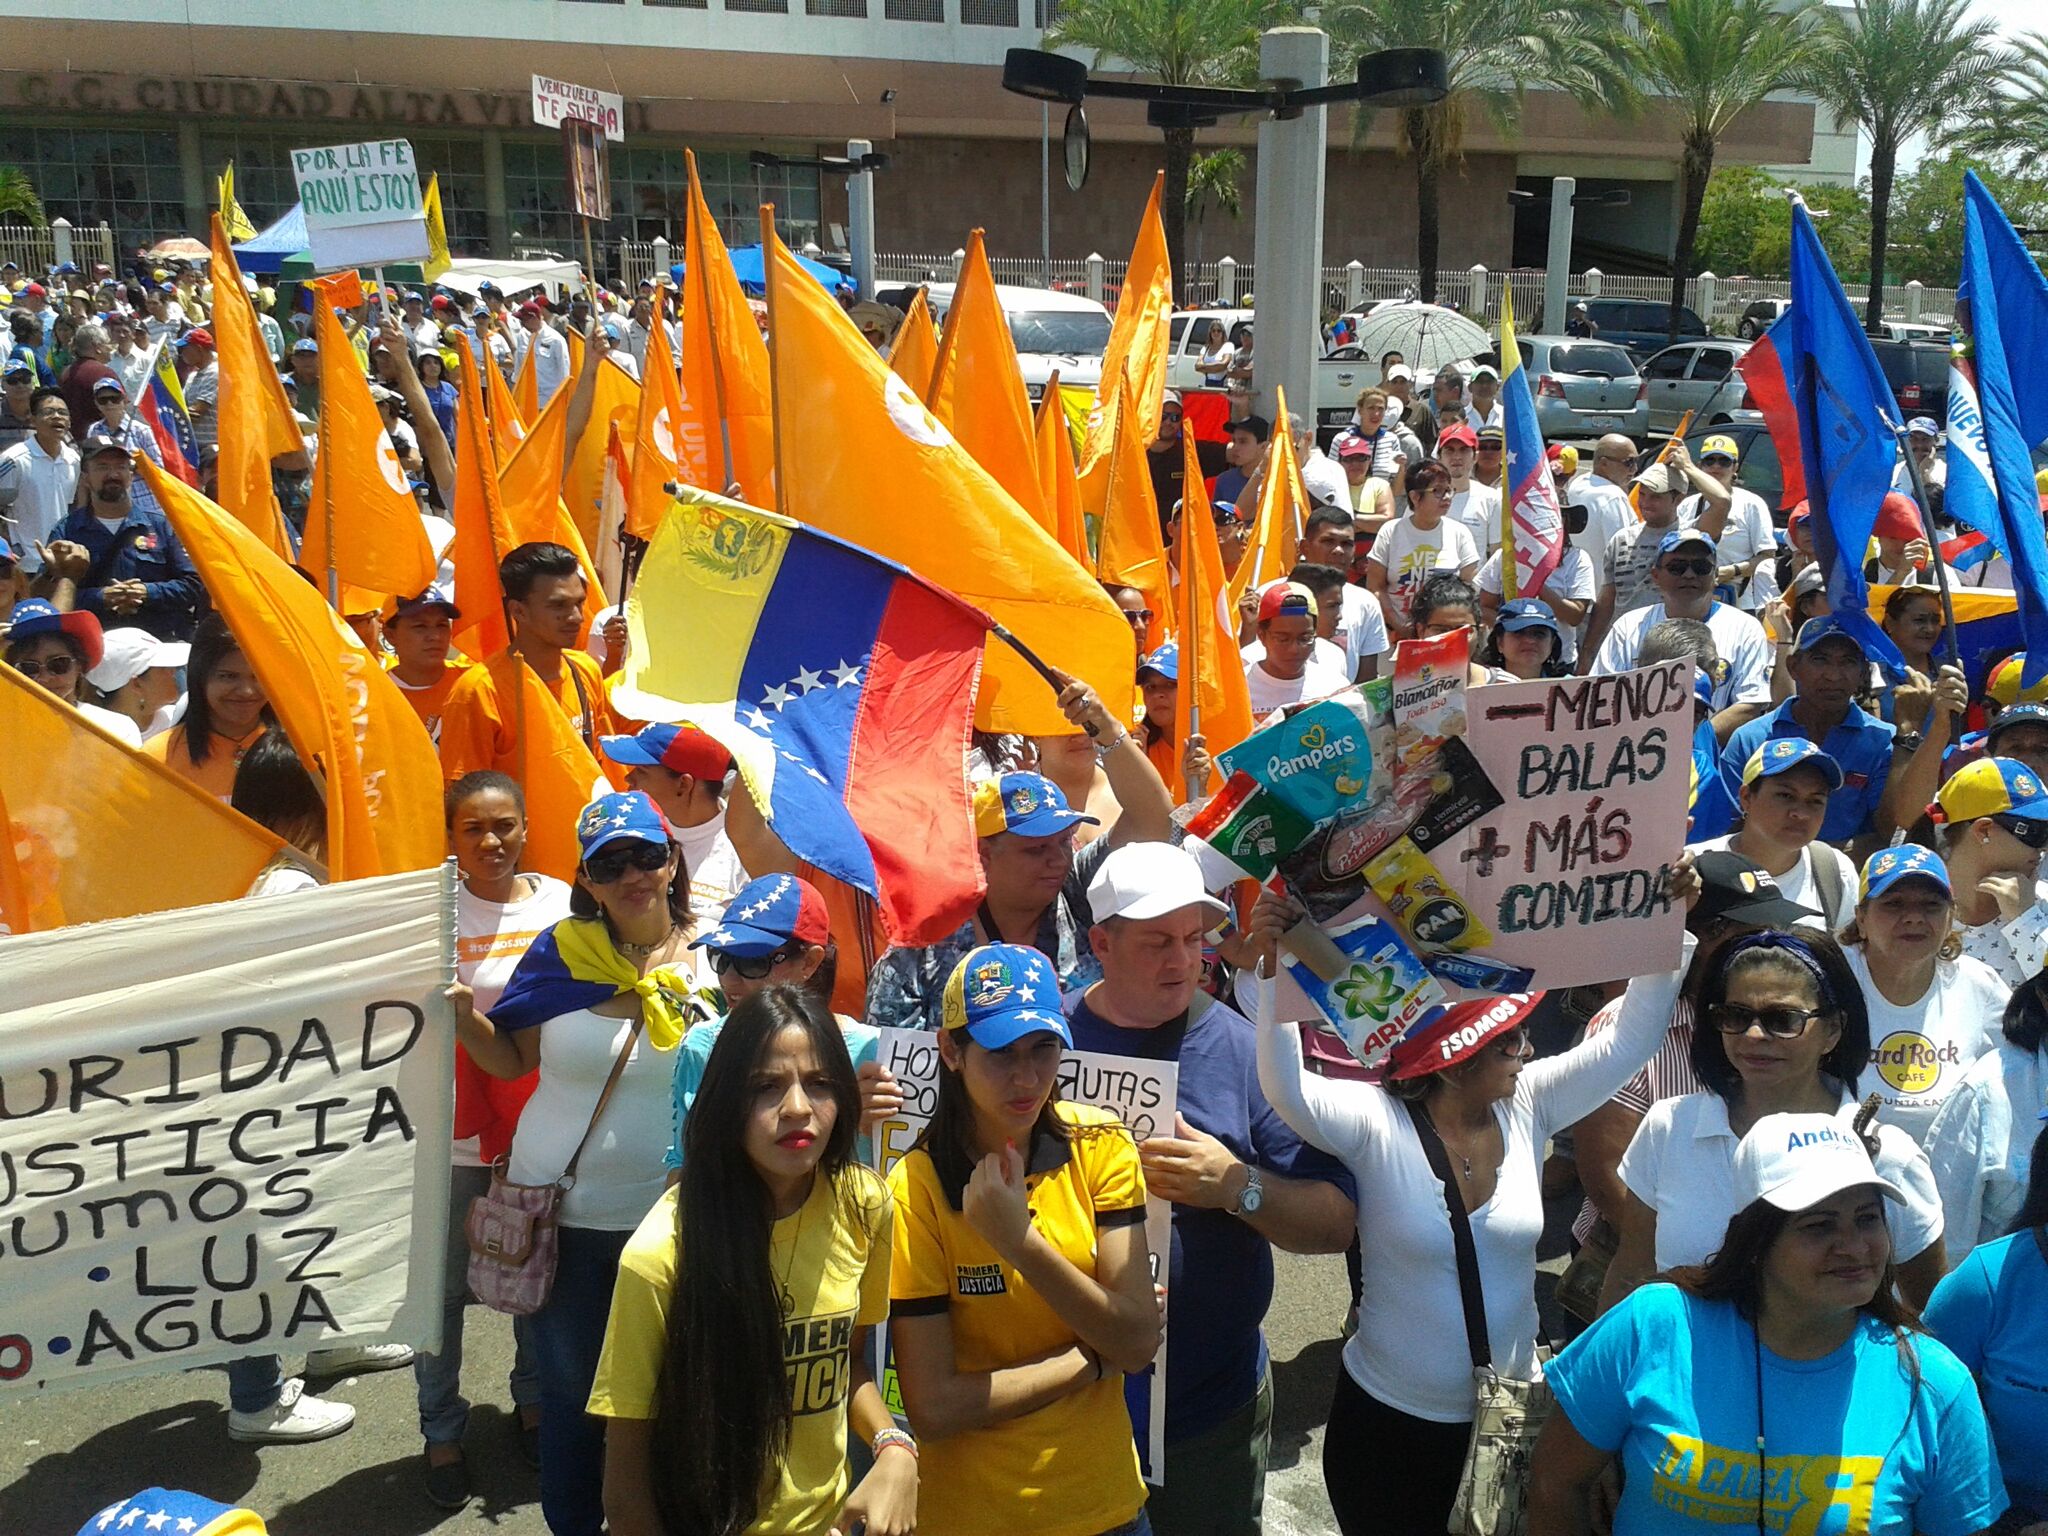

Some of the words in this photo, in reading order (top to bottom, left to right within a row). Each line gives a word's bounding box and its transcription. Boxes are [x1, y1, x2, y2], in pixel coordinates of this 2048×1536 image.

[136, 79, 332, 115] CIUDAD
[350, 87, 464, 124] ALTA
[537, 94, 559, 120] TE
[295, 149, 340, 173] POR
[346, 144, 371, 168] LA
[380, 141, 409, 166] FE
[354, 172, 416, 213] ESTOY
[1394, 679, 1461, 710] Blancaflor
[1545, 662, 1688, 732] MENOS
[1267, 735, 1356, 783] Pampers
[1517, 727, 1668, 799] BALAS
[1524, 796, 1633, 873] MÁS
[1496, 863, 1674, 933] COMIDA
[1435, 960, 1485, 977] OREO
[1363, 995, 1431, 1056] ARIEL
[1869, 1044, 1906, 1066] ard
[1908, 1040, 1960, 1068] Rock
[1897, 1073, 1926, 1083] CAFE
[1884, 1098, 1920, 1107] UNTA
[136, 1226, 345, 1297] LUZ
[957, 1264, 1001, 1276] PRIMERO
[959, 1276, 1005, 1293] JUSTICIA
[76, 1284, 344, 1367] AGUA
